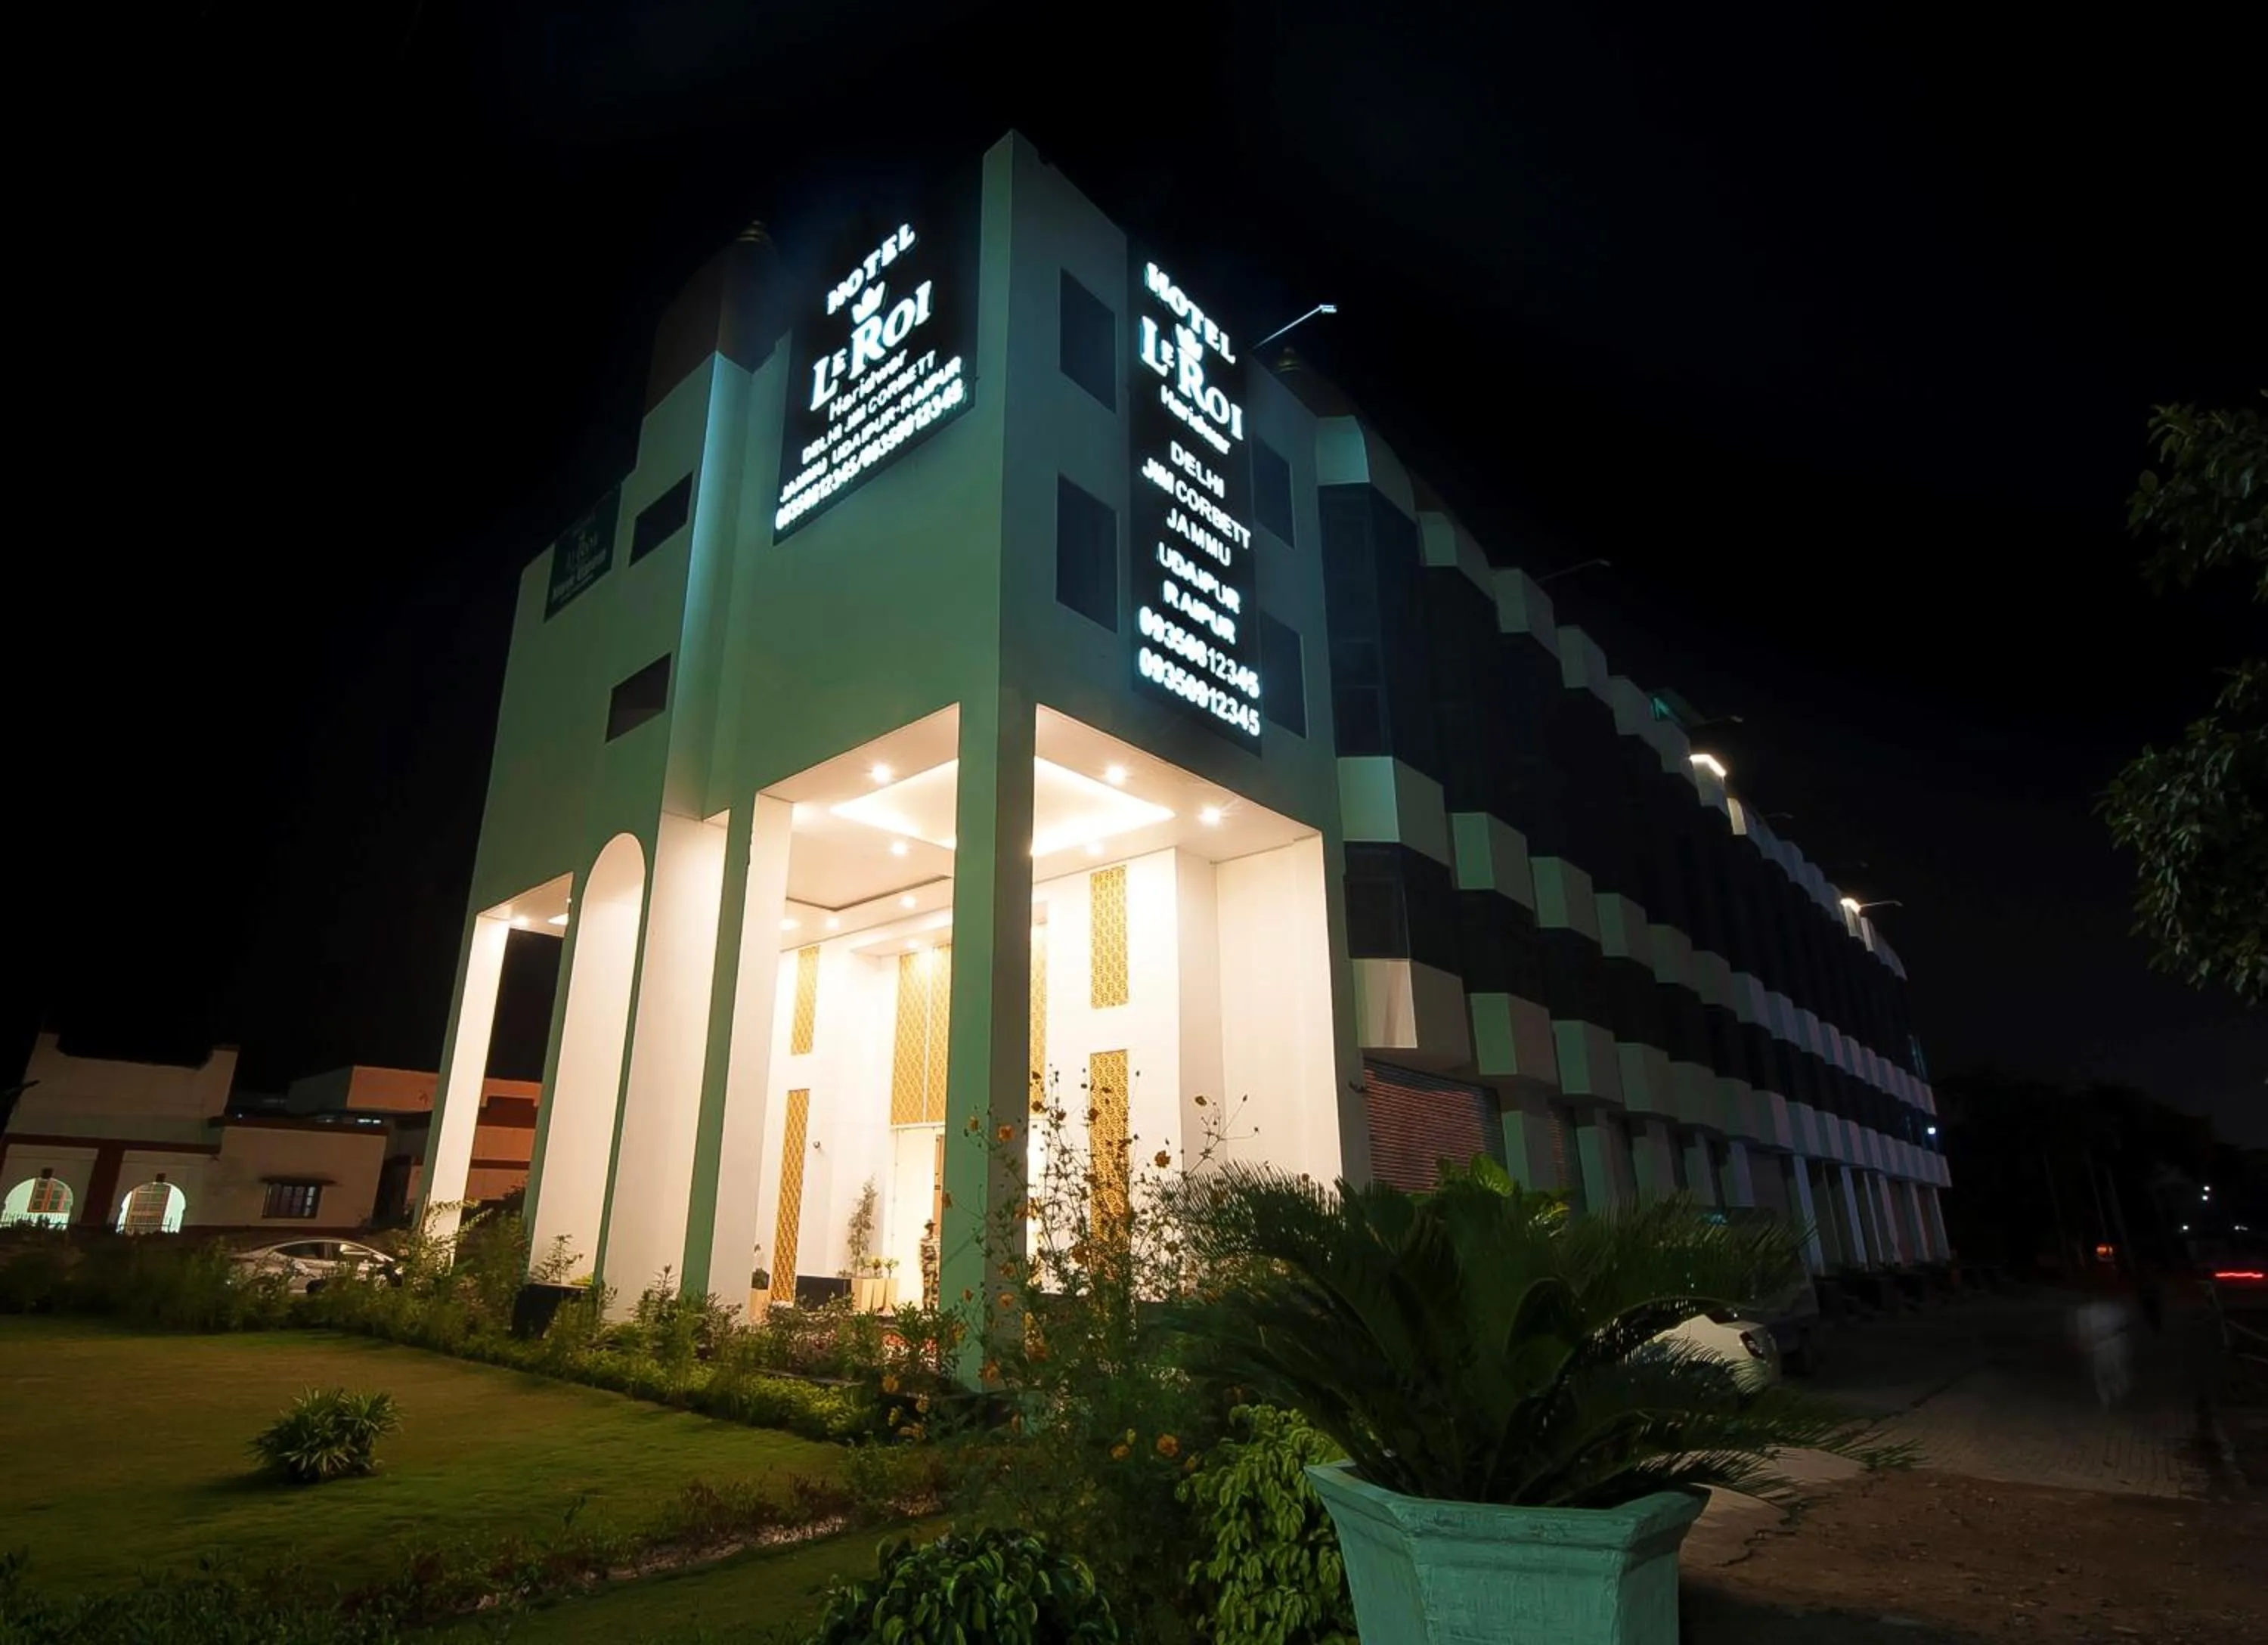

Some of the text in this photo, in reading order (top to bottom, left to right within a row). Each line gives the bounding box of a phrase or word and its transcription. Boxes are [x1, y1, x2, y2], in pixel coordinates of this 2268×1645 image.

[828, 224, 915, 314] HOTEL
[1148, 263, 1235, 364] HOTEL
[849, 280, 931, 379] ROI
[802, 351, 936, 464] DELHI JIM CORBETT
[829, 349, 907, 420] Haridwar
[1178, 349, 1243, 440] ROI
[1142, 459, 1250, 549] JIM CORBETT
[1171, 441, 1224, 498] DELHI
[1158, 542, 1240, 614] UDAIPUR
[1167, 508, 1230, 565] JAMMU
[1163, 581, 1235, 644] RAIPUR
